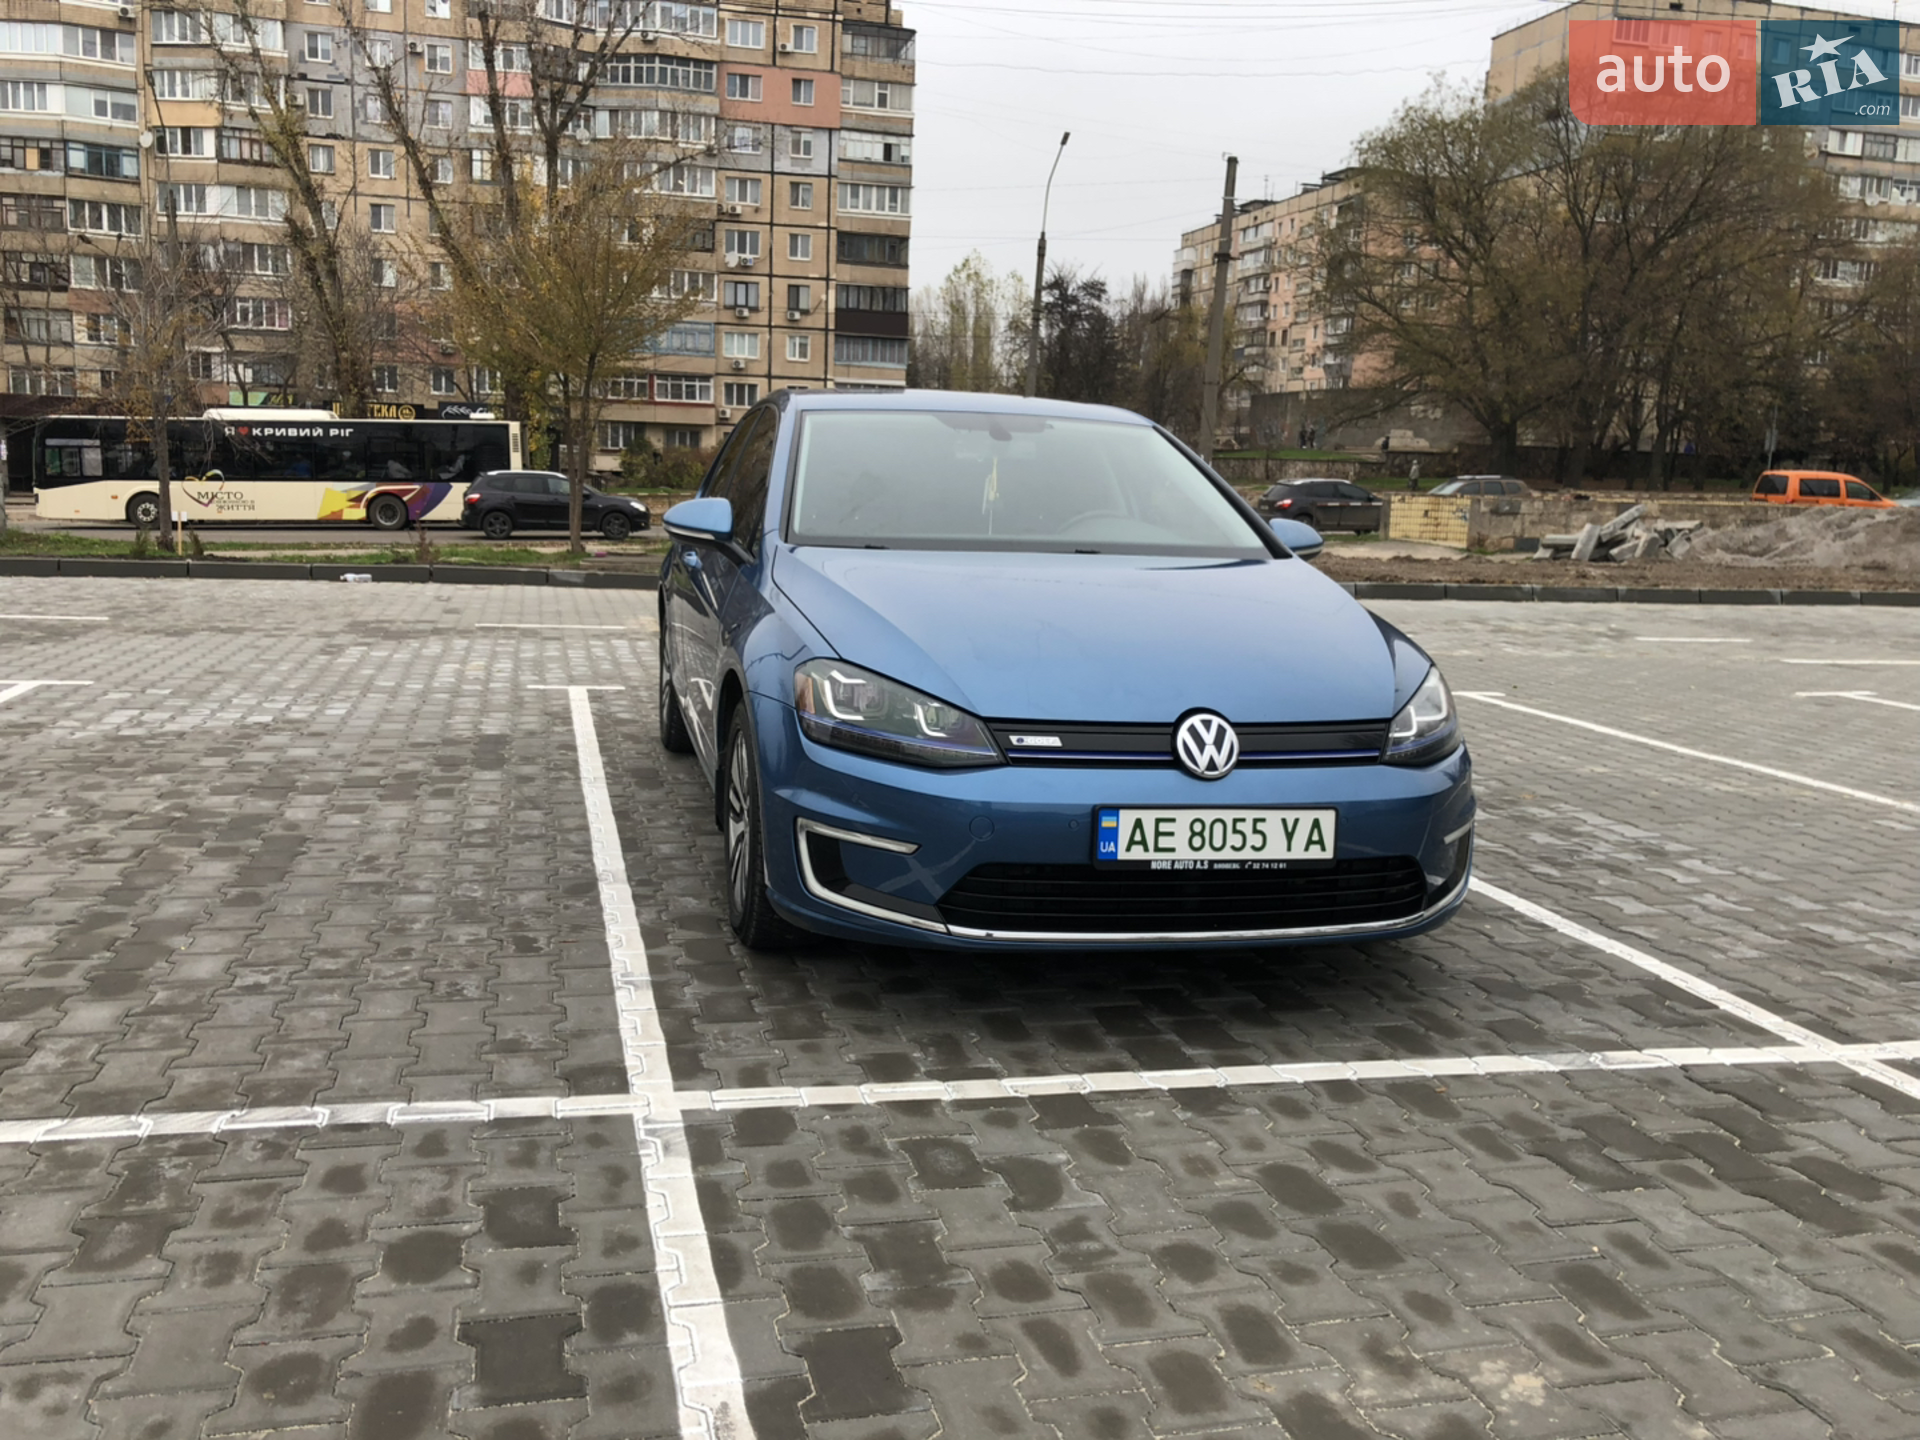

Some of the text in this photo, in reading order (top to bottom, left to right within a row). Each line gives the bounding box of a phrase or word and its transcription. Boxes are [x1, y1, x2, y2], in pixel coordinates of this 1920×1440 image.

[224, 426, 354, 437] Я КРИВИЙ РІГ
[197, 491, 244, 501] МІСТО
[1125, 817, 1327, 853] AE 8055 YA
[1100, 841, 1116, 853] UA
[1173, 860, 1194, 870] AUTO
